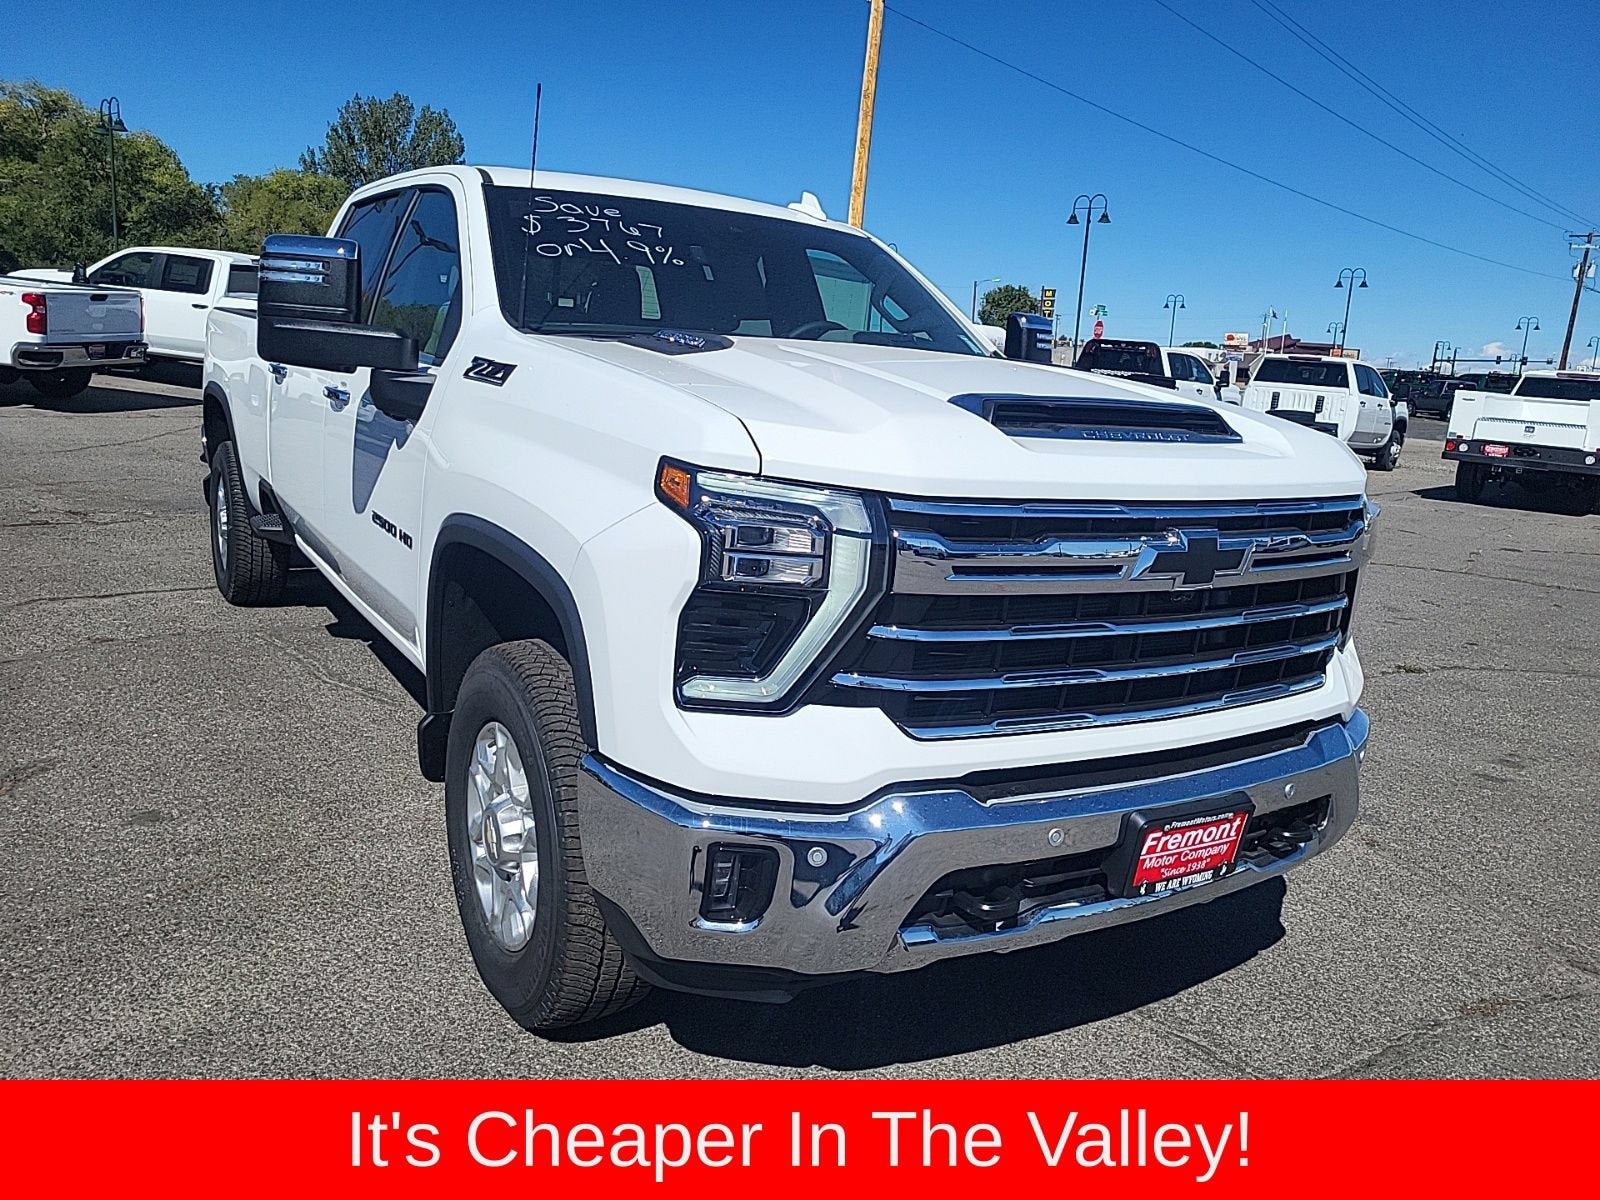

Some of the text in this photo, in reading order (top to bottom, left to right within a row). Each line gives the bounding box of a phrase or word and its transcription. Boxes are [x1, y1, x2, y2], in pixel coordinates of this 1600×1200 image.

[534, 196, 621, 217] Save
[371, 510, 412, 550] 2500 HD
[1141, 816, 1241, 855] Fremont
[1143, 843, 1230, 869] Motor Company
[1161, 859, 1211, 877] "Since 1938"
[1155, 870, 1213, 892] WE ARE WYOMING
